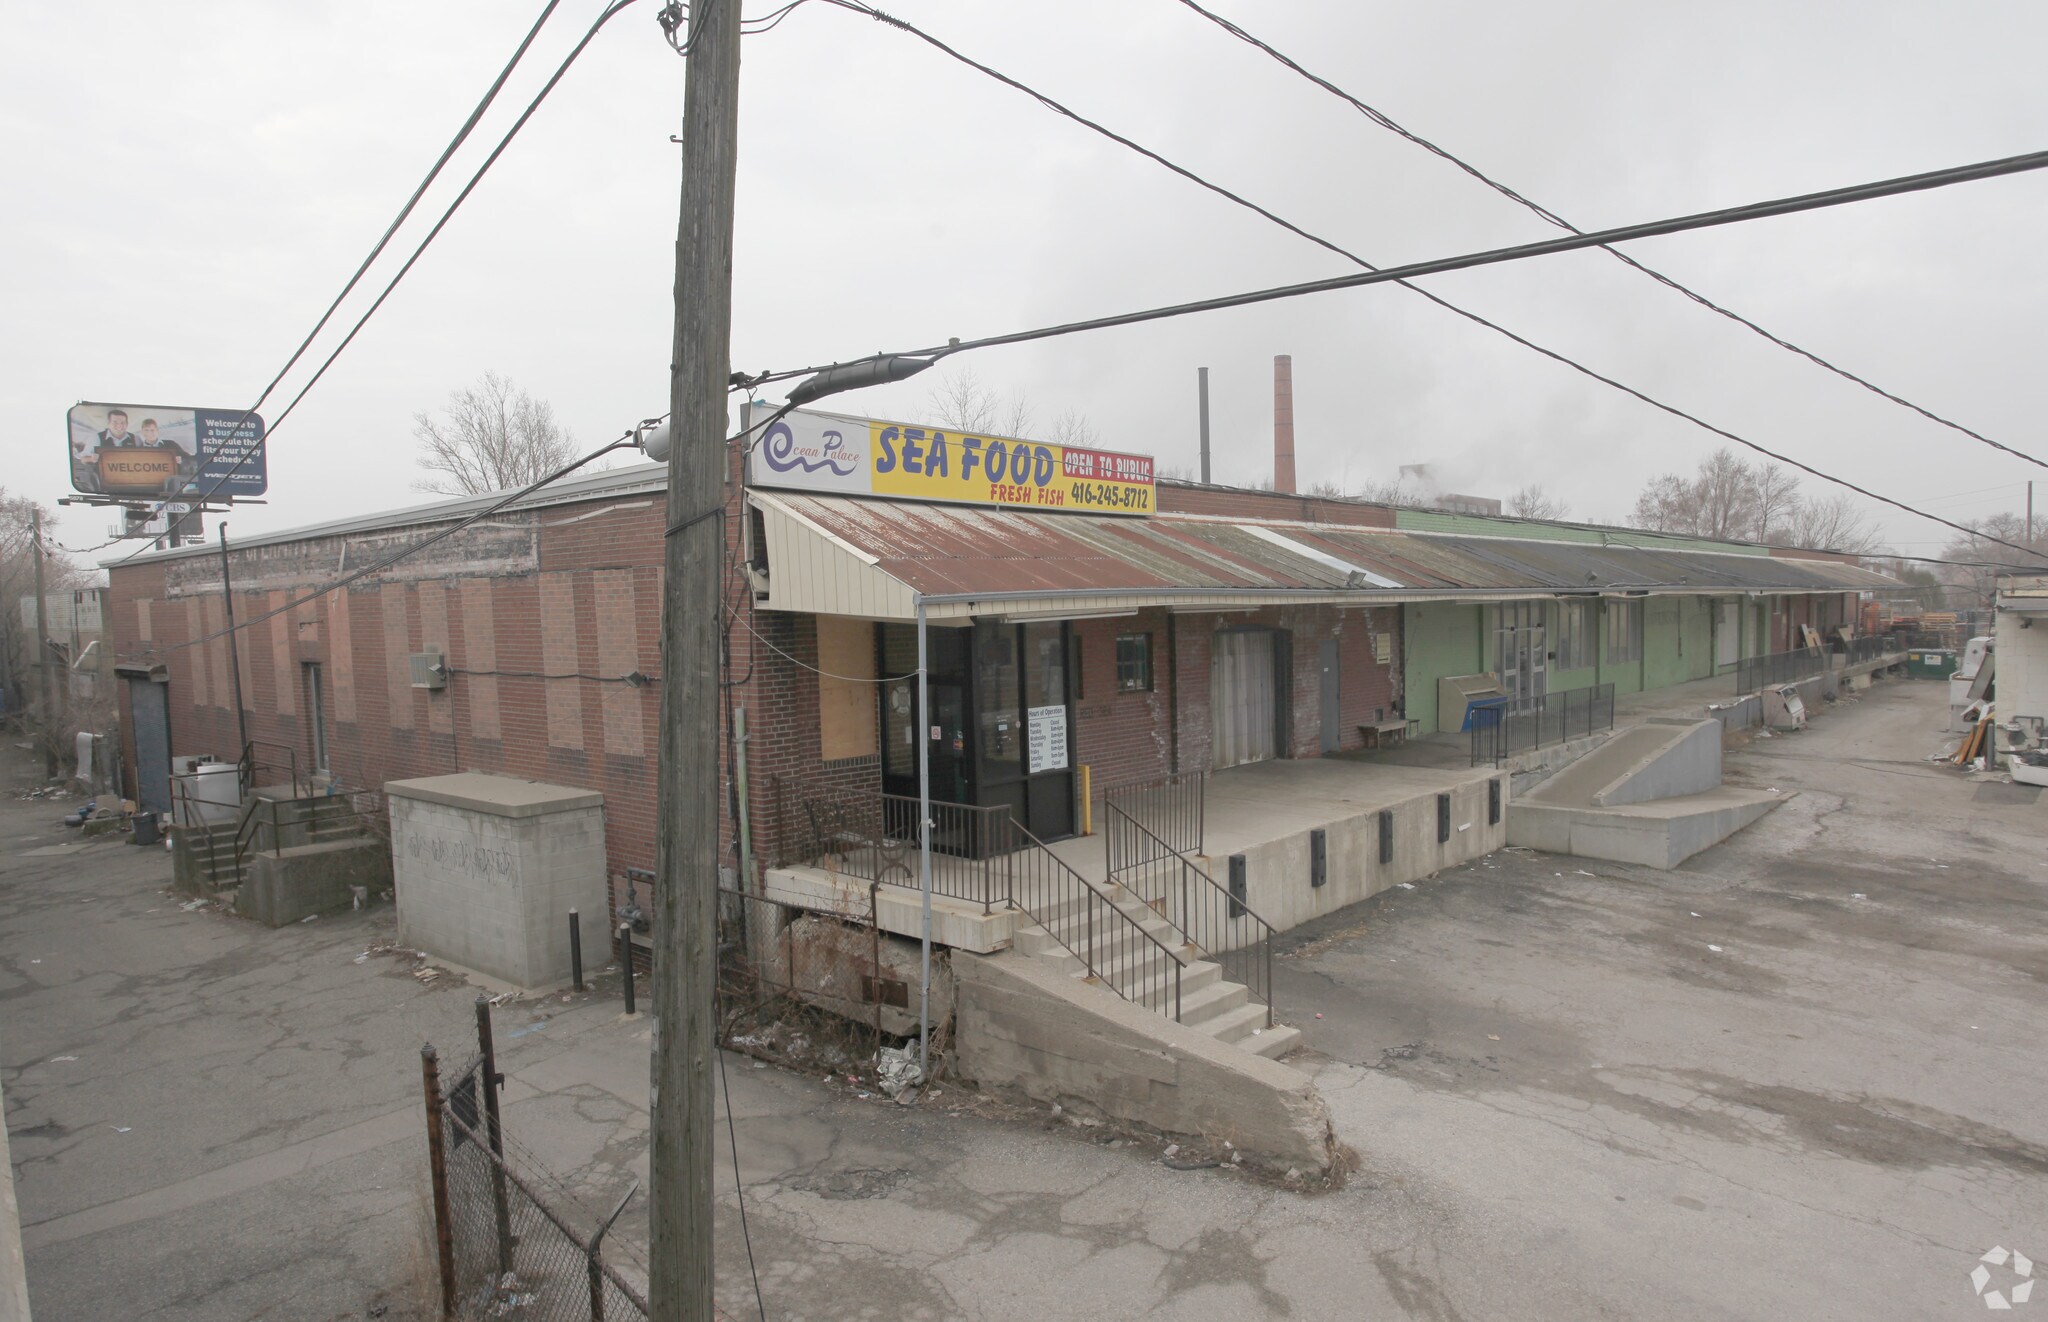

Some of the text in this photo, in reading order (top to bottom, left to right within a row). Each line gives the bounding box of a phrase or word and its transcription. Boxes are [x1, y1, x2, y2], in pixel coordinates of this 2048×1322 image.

[205, 419, 256, 429] Welcome to
[215, 428, 254, 437] busness
[202, 437, 242, 446] scheule
[763, 422, 860, 472] Ocean Palace
[212, 455, 255, 464] schede.
[876, 426, 1054, 487] SEA FOOD
[107, 462, 170, 473] WELCOME
[1065, 452, 1150, 482] OPEN TO PUBLIC
[990, 483, 1065, 507] FRESH FISH
[1071, 481, 1148, 509] 416-245-8712
[165, 502, 187, 513] CBS
[1046, 708, 1062, 717] Operation
